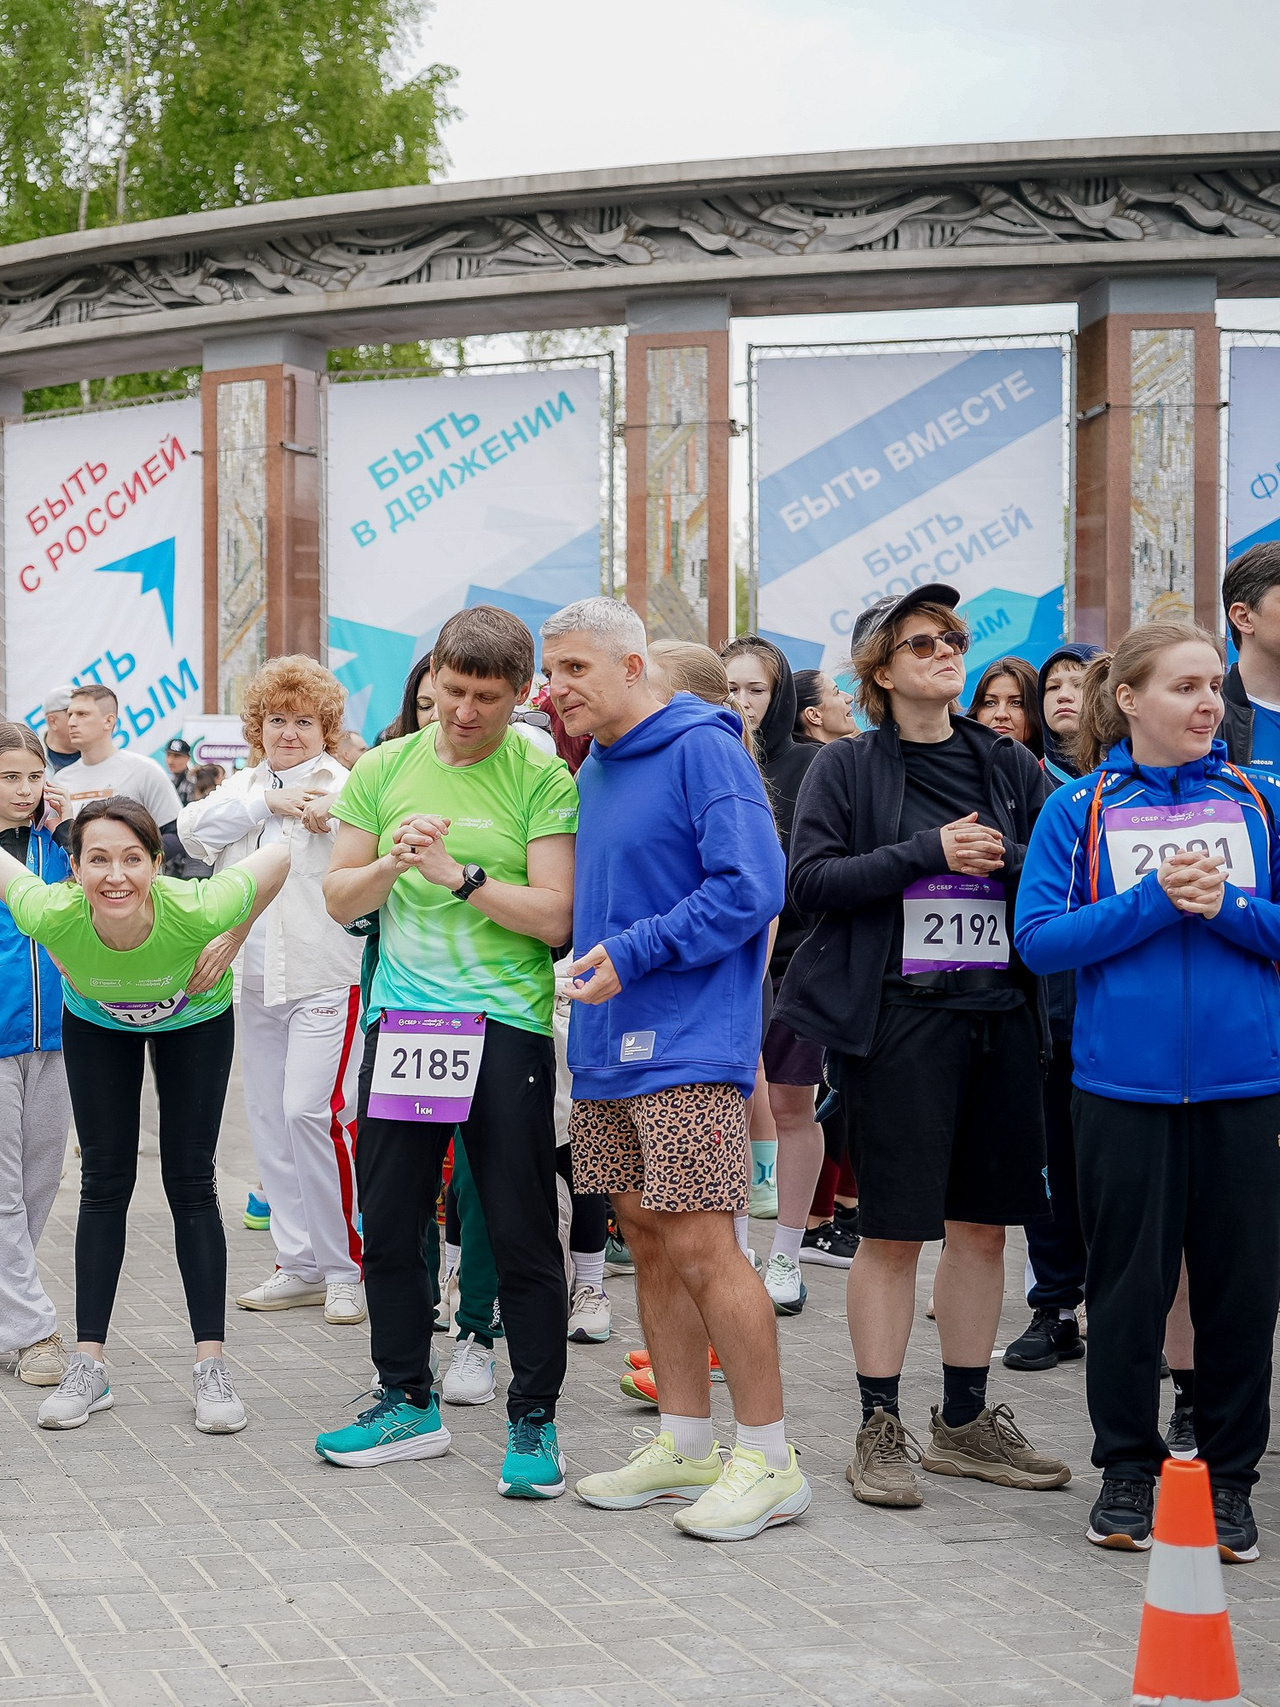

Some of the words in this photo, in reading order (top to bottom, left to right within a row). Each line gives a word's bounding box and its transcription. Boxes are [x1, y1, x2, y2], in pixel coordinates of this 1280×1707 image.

[350, 519, 377, 547] В
[384, 390, 576, 533] ДВИЖЕНИИ
[367, 410, 481, 491] БЫТЬ
[779, 464, 881, 533] БЫТЬ
[883, 370, 1035, 472] ВМЕСТЕ
[19, 565, 41, 592] С
[45, 433, 186, 572] РОССИЕЙ
[26, 461, 108, 536] БЫТЬ
[862, 513, 963, 578] БЫТЬ
[25, 649, 136, 737] БТЬ
[923, 912, 1001, 946] 2192
[391, 1047, 470, 1081] 2185
